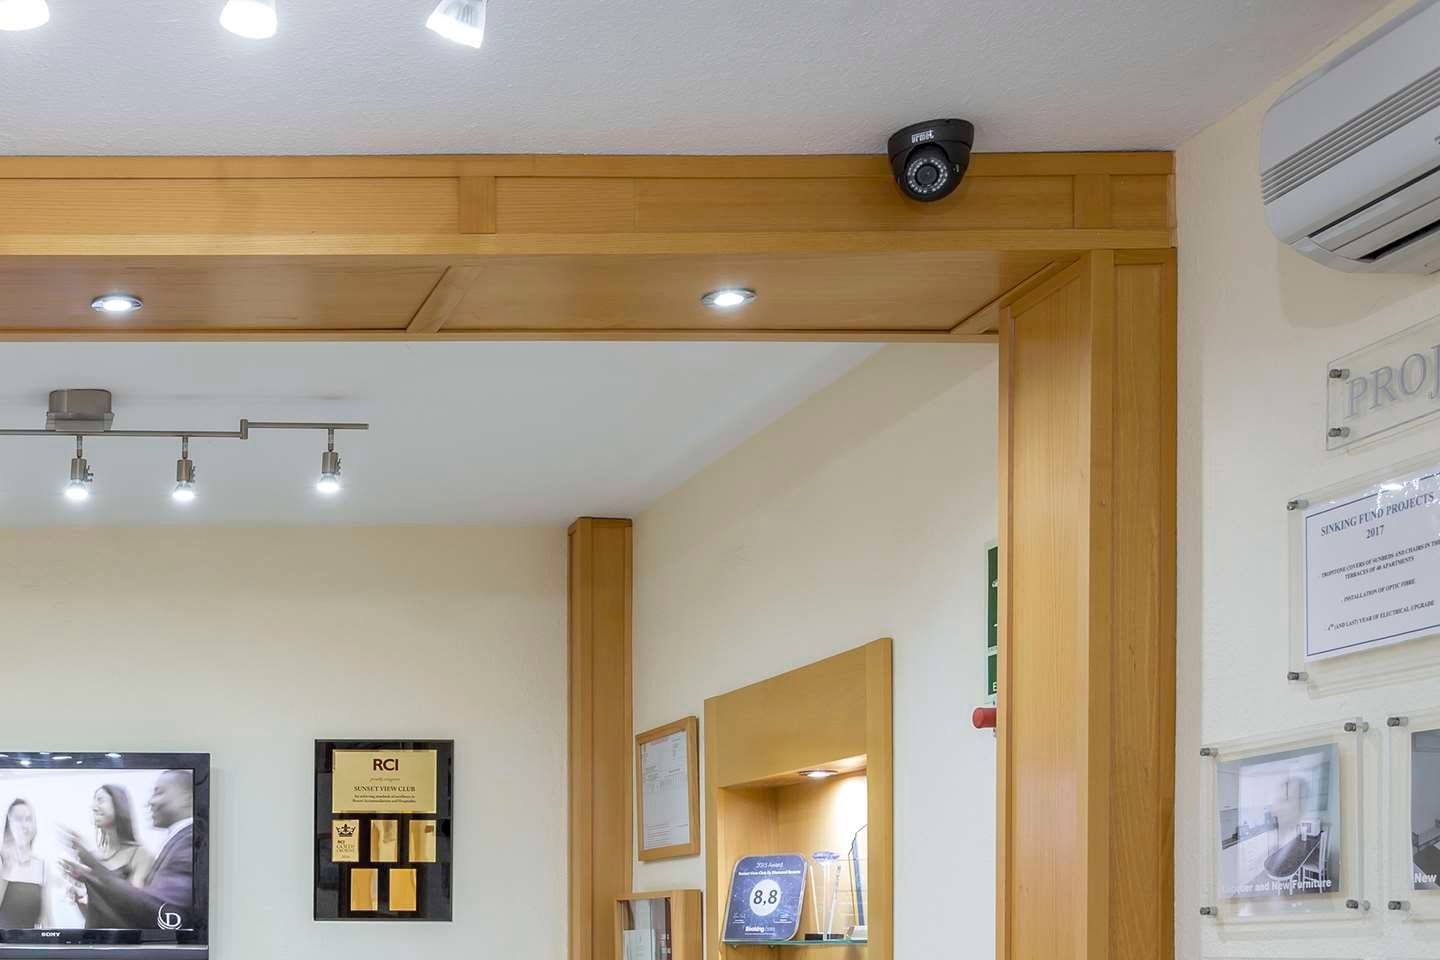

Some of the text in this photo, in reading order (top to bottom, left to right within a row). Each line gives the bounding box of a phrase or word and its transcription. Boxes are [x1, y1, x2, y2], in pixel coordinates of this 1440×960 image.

[911, 129, 935, 144] urmet
[1321, 491, 1435, 536] SINKING FUND PROJECTS
[1366, 525, 1385, 539] 2017
[1383, 555, 1415, 570] APARTMENTS
[1385, 582, 1401, 592] OPTIC
[1380, 606, 1410, 619] ELECTRICAL
[373, 758, 399, 771] RCI
[1414, 872, 1437, 883] New
[1272, 880, 1291, 891] New
[1292, 879, 1332, 890] Furniture
[753, 889, 778, 905] 8,8
